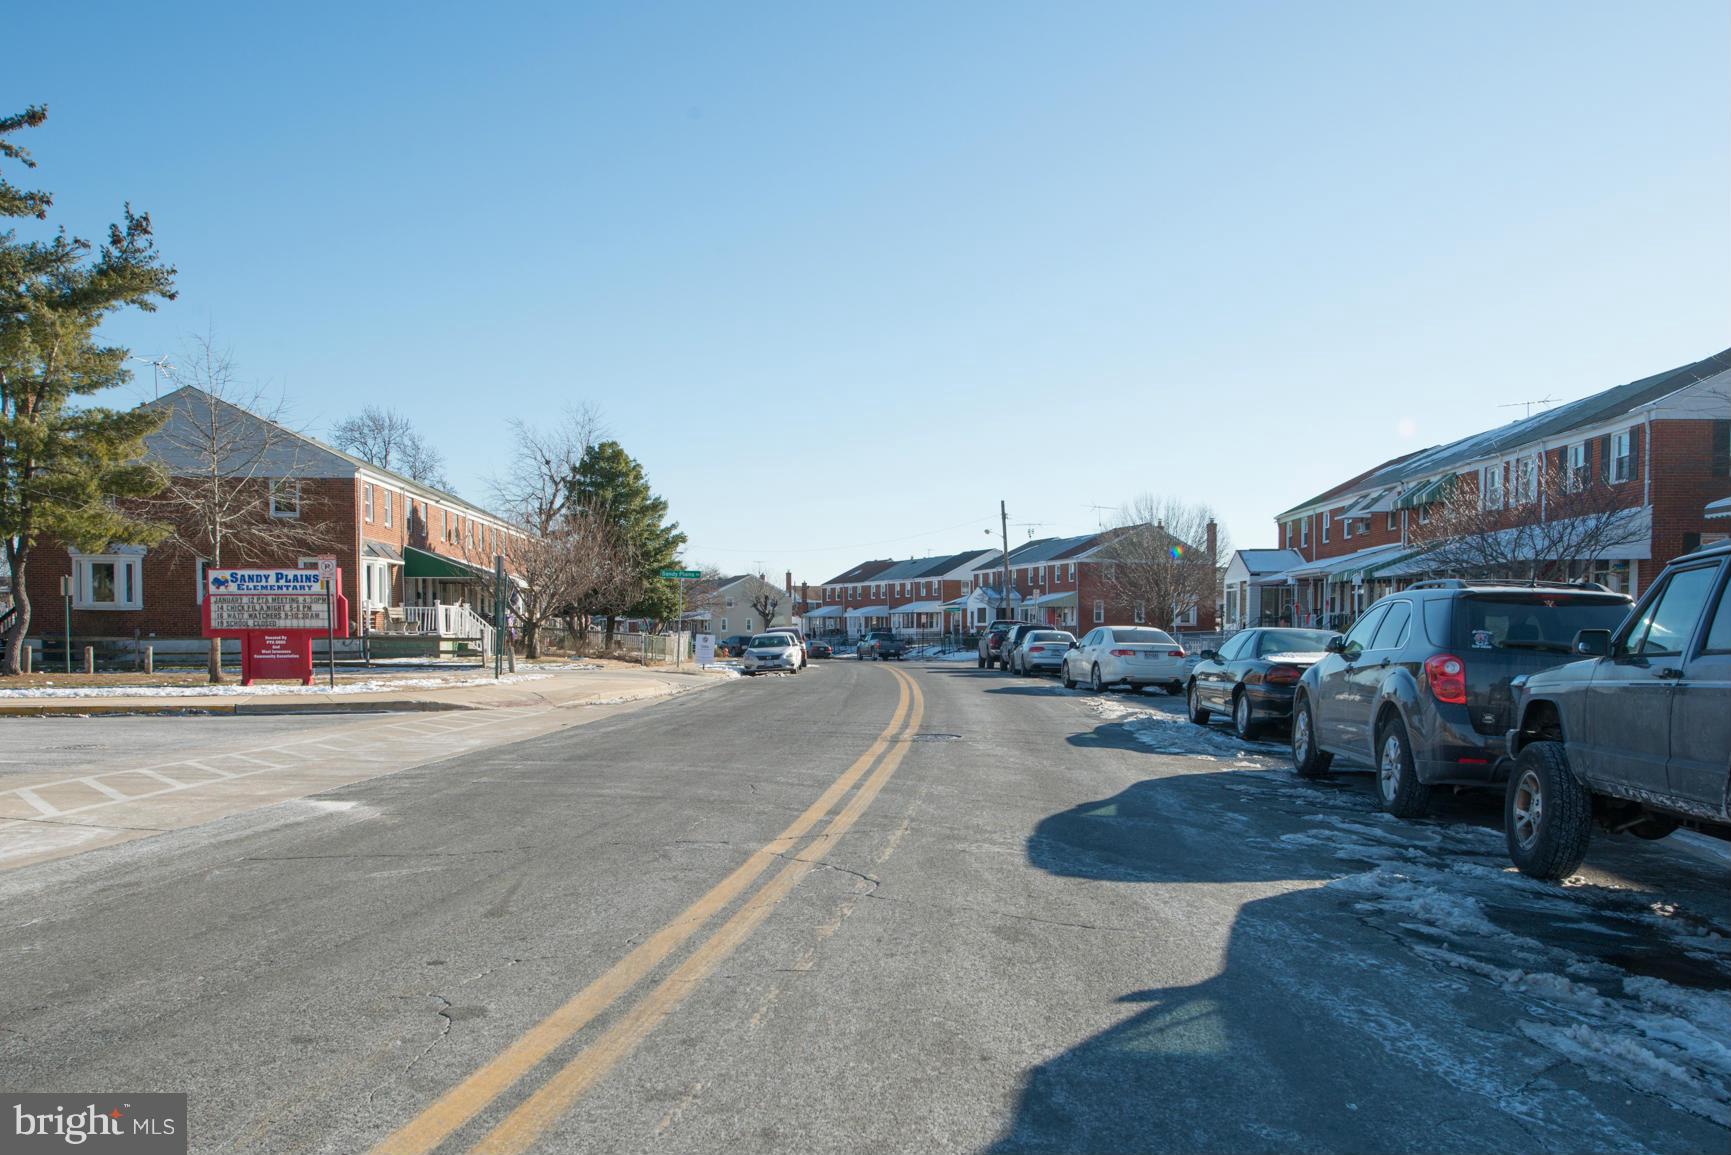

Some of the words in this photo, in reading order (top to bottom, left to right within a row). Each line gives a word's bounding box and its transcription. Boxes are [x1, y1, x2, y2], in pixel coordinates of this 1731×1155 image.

[230, 572, 270, 584] SANDY
[275, 572, 320, 583] PLAINS
[661, 570, 677, 578] Sandy
